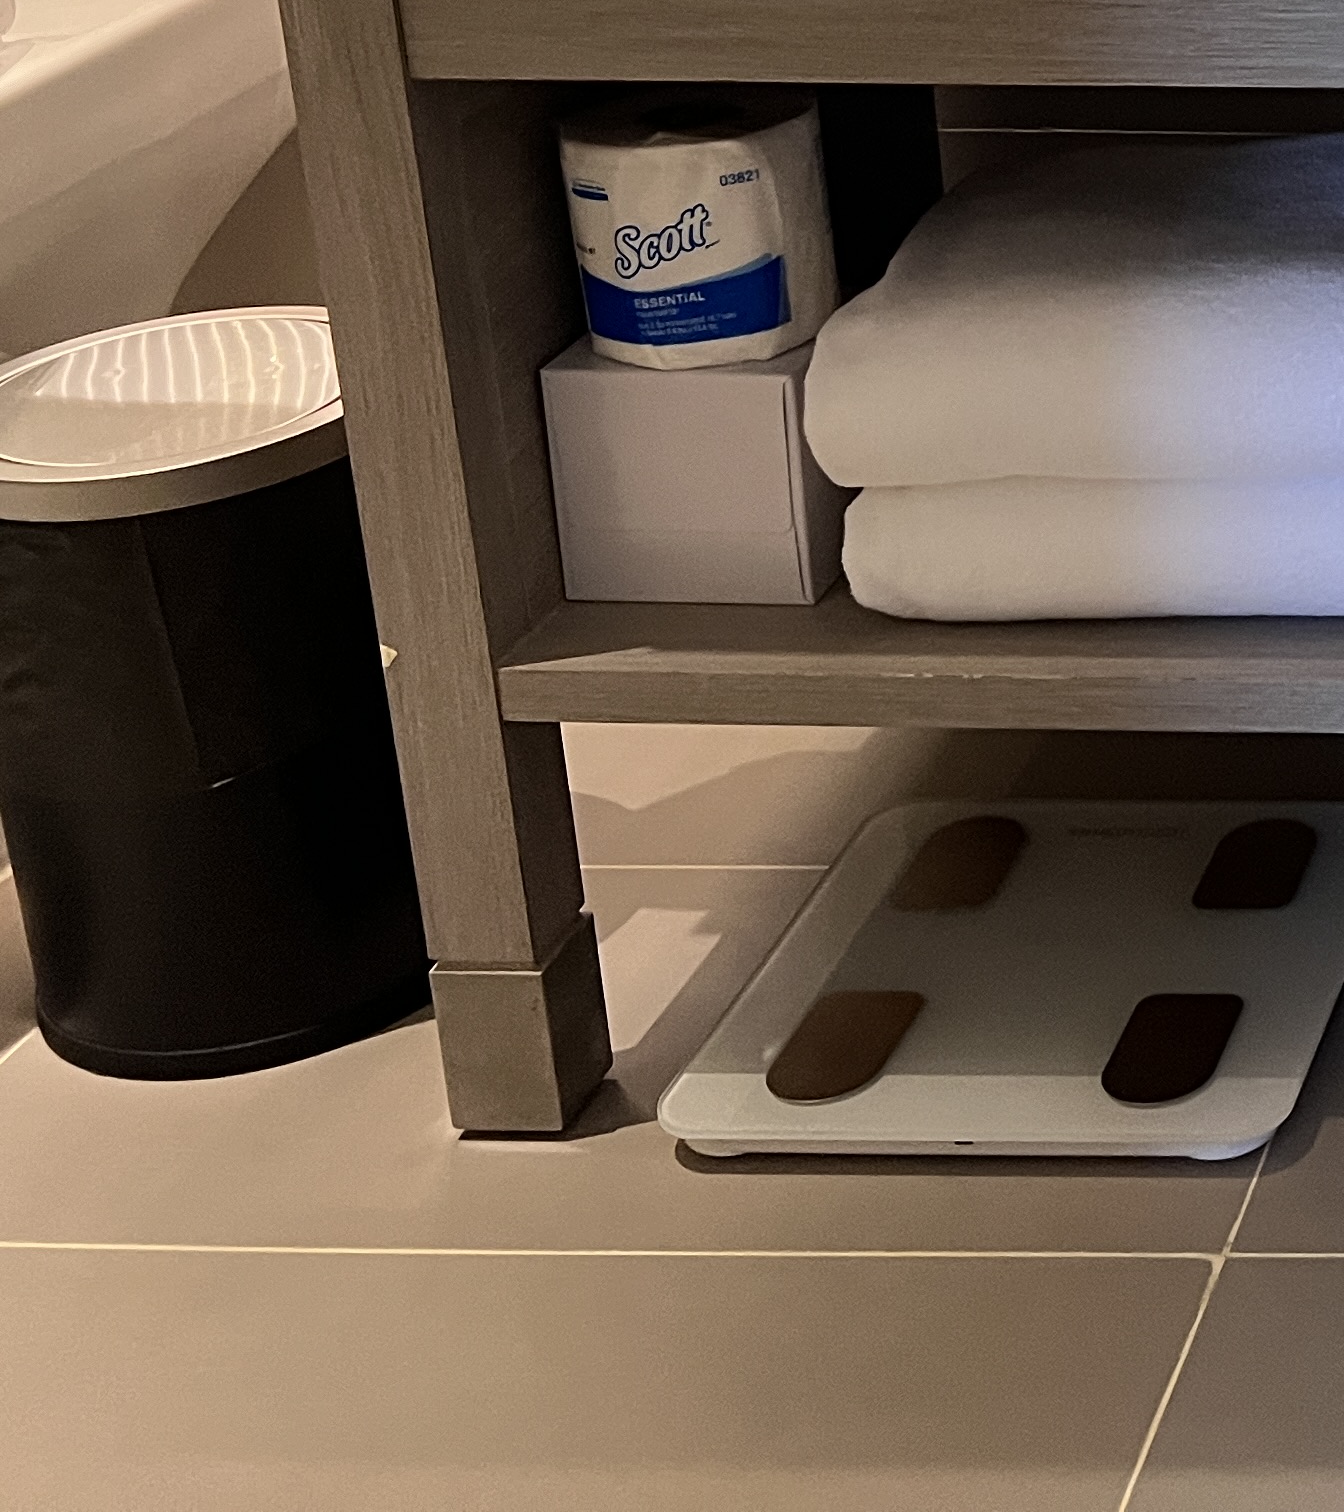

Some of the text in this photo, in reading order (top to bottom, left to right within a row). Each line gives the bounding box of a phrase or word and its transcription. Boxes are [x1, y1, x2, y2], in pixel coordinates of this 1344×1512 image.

[719, 168, 760, 186] 03821
[614, 203, 709, 279] Scott
[634, 290, 706, 309] ESSENTIAL
